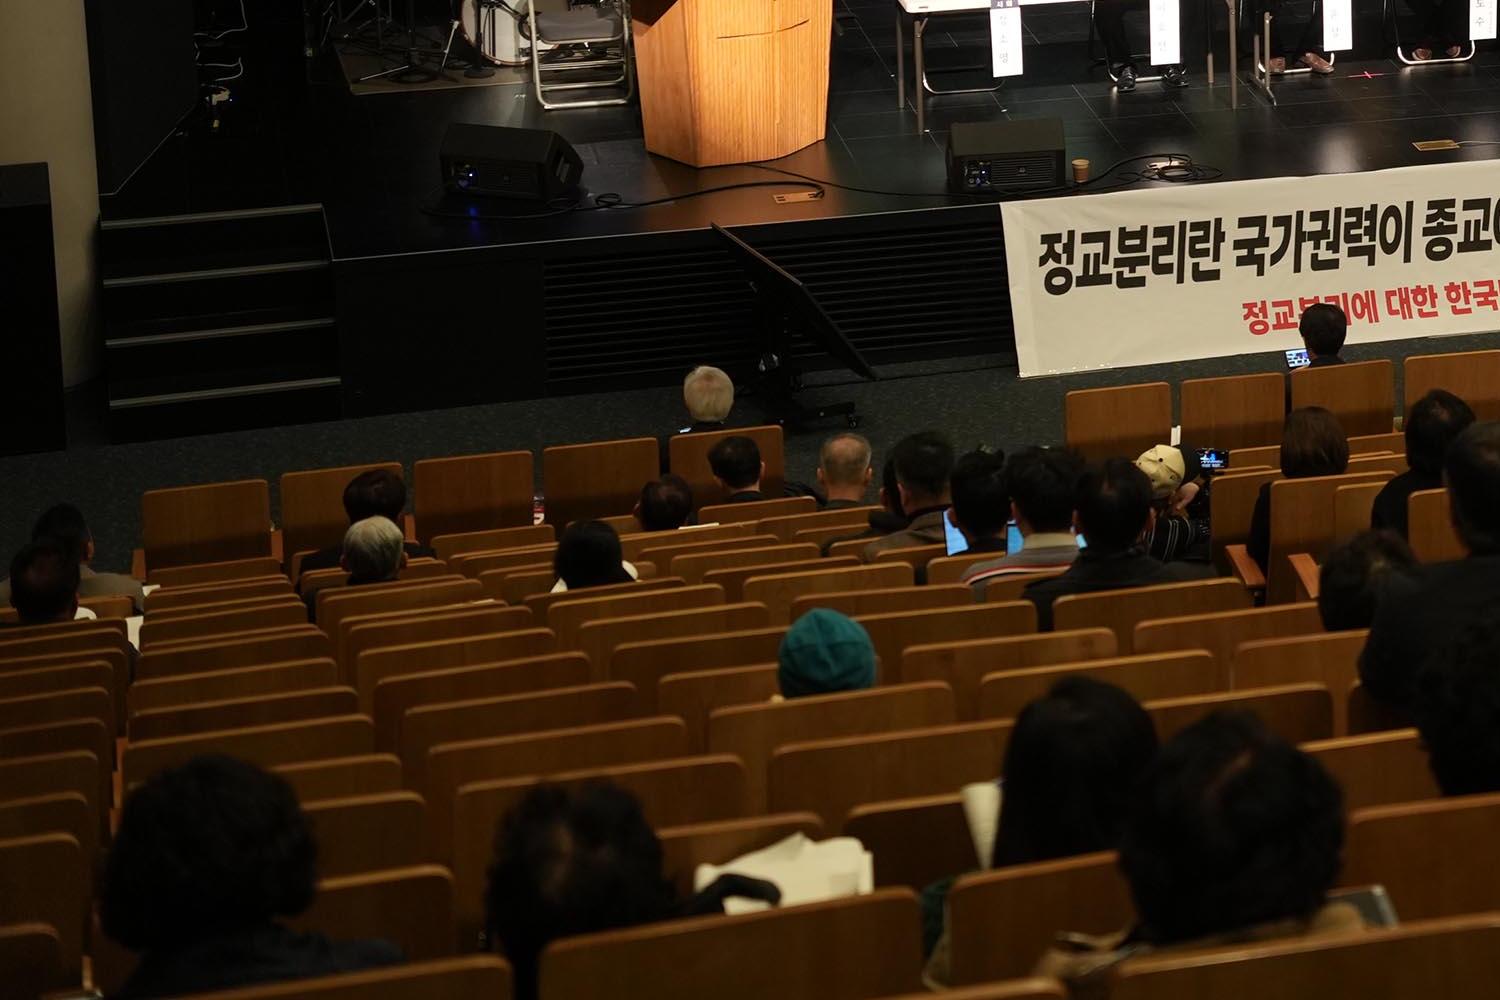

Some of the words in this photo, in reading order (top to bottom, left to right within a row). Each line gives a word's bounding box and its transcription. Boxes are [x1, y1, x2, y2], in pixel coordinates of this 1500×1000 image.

[1037, 216, 1226, 296] 정교분리란
[1231, 201, 1414, 276] 국가권력이
[1385, 284, 1439, 320] 대한
